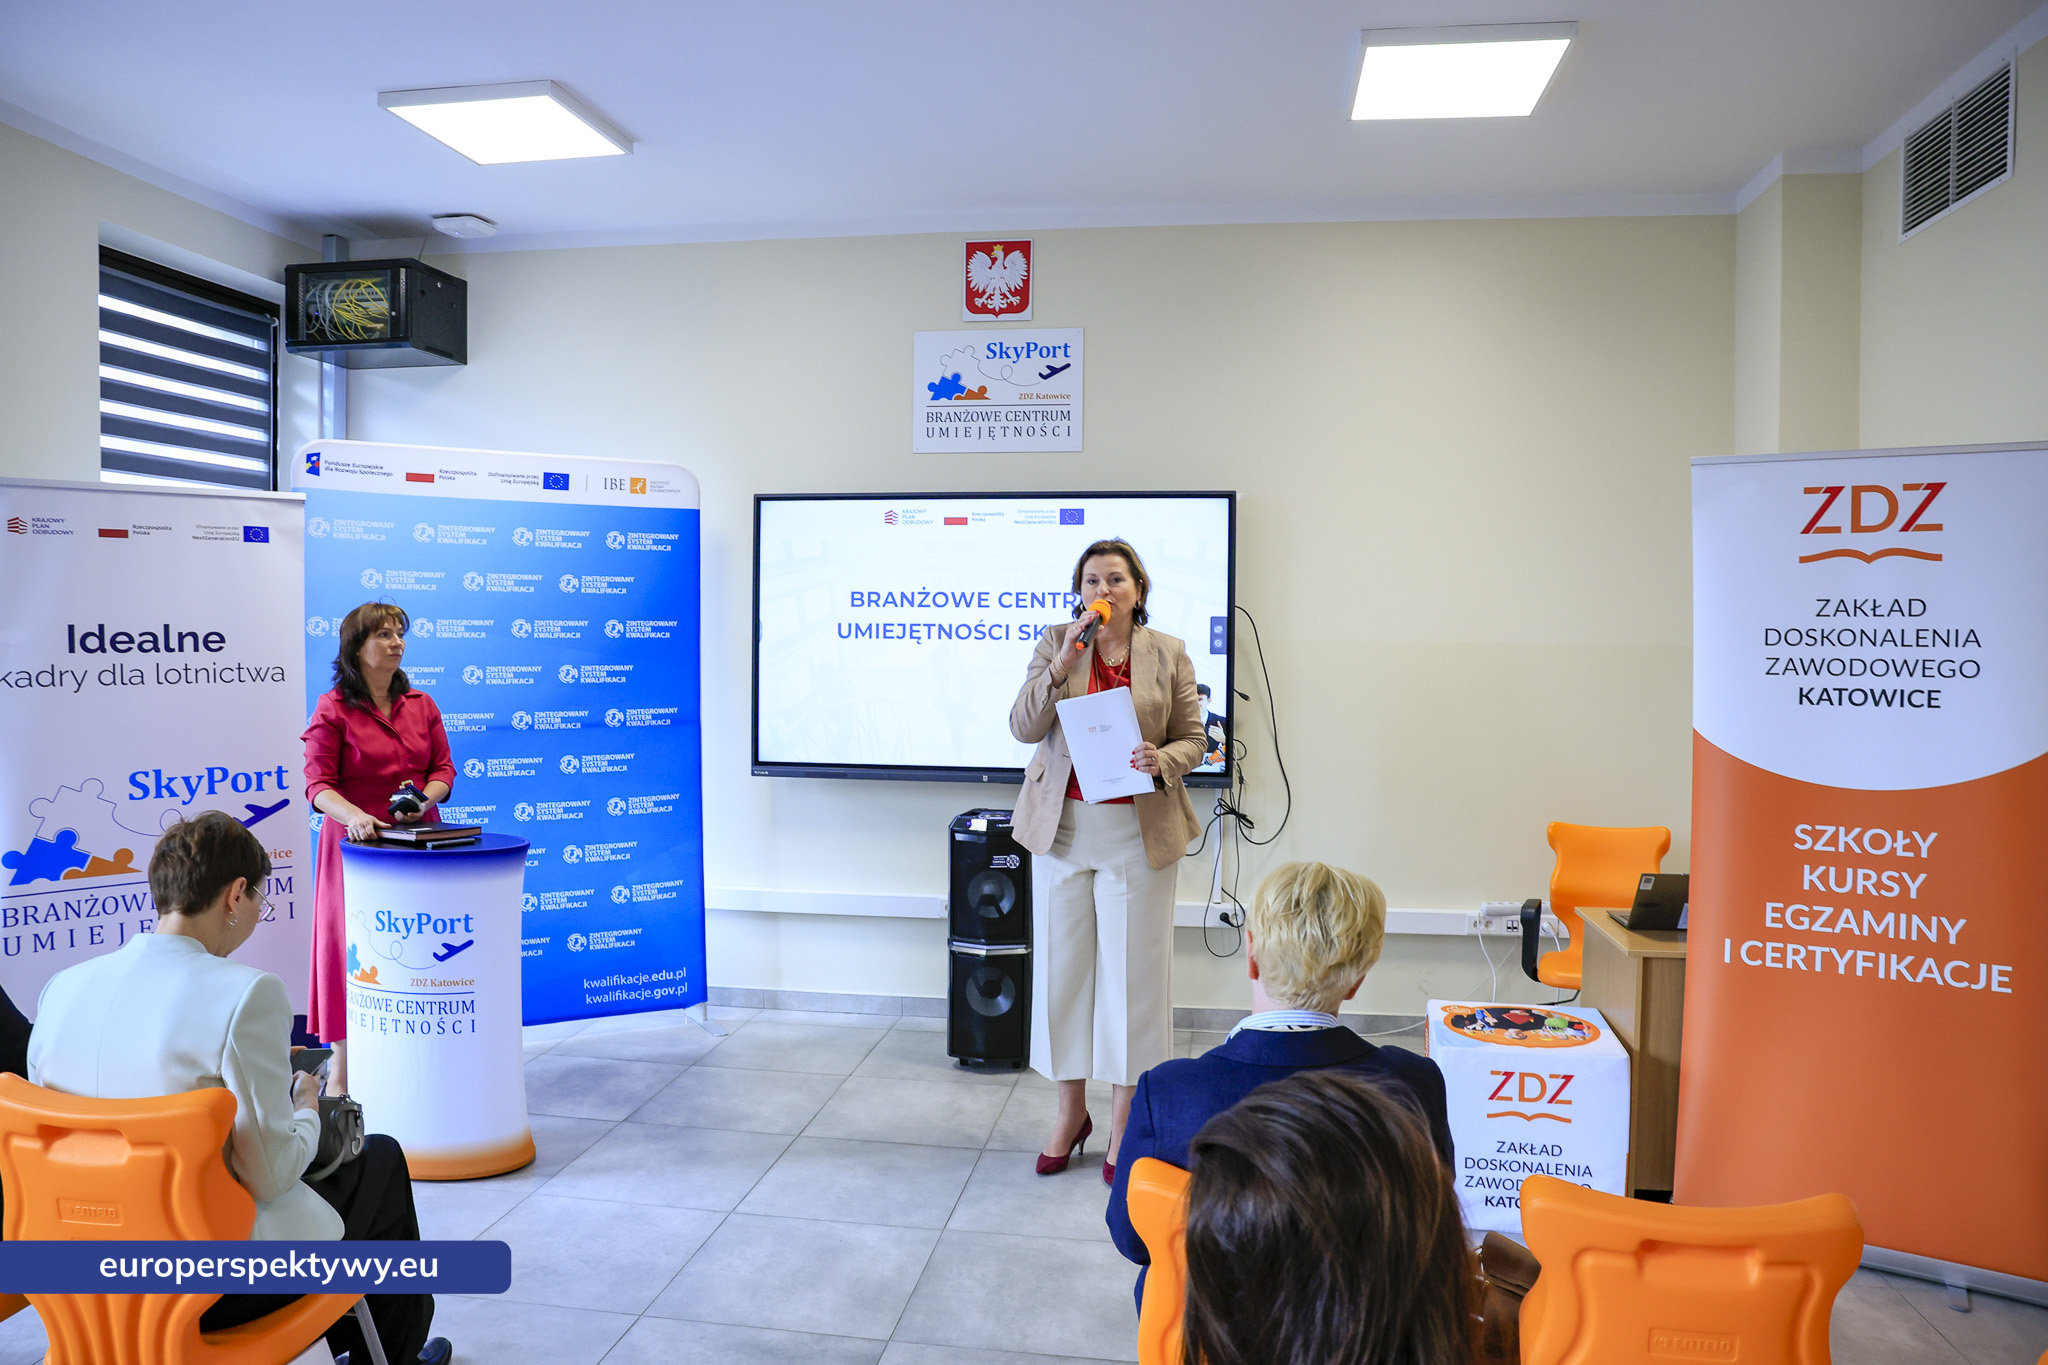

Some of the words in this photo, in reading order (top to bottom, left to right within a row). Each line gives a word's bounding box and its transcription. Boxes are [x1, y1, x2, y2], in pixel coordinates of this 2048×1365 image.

[986, 342, 1071, 364] SkyPort
[926, 409, 1001, 423] BRANŻOWE
[1005, 410, 1071, 422] CENTRUM
[926, 423, 1071, 440] UMIEJĘTNOŚCI
[352, 463, 384, 471] Europejskie
[604, 477, 626, 491] IBE
[1800, 482, 1948, 534] ZDZ
[333, 519, 395, 529] ZINTEGROWANY
[437, 524, 496, 533] ZINTEGROWANY
[333, 532, 386, 541] KWALIFIKACJI
[535, 529, 590, 537] ZINTEGROWANY
[627, 532, 679, 540] ZINTEGROWANY
[437, 537, 487, 545] KWALIFIKACJI
[535, 541, 582, 549] KWALIFIKACJI
[627, 544, 671, 552] KWALIFIKACJI
[385, 570, 446, 579] ZINTEGROWANY
[385, 583, 437, 591] KWALIFIKACJI
[581, 587, 626, 595] KWALIFIKACJI
[850, 587, 990, 608] BRANŻOWE
[1815, 598, 1927, 617] ZAKŁAD
[837, 620, 1010, 644] UMIEJĘTNOŚCI
[67, 624, 226, 653] Idealne
[1764, 628, 1982, 648] DOSKONALENIA
[1765, 657, 1981, 678] ZAWODOWEGO
[98, 663, 145, 686] dla
[156, 662, 286, 684] lotnictwa
[1798, 687, 1941, 709] KATOWICE
[534, 710, 589, 718] ZINTEGROWANY
[626, 707, 678, 715] ZINTEGROWANY
[534, 722, 581, 730] KWALIFIKACJI
[626, 719, 670, 727] KWALIFIKACJI
[487, 757, 543, 765] ZINTEGROWANY
[582, 753, 635, 761] ZINTEGROWANY
[582, 765, 627, 774] KWALIFIKACJI
[128, 766, 290, 805] SkyPort
[628, 794, 680, 803] ZINTEGROWANY
[439, 805, 496, 813] ZINTEGROWANY
[536, 800, 591, 809] ZINTEGROWANY
[628, 806, 672, 815] KWALIFIKACJI
[536, 813, 583, 821] KWALIFIKACJI
[584, 841, 637, 850] ZINTEGROWANY
[1794, 824, 1938, 858] SZKOŁY
[585, 854, 630, 862] KWALIFIKACJI
[632, 880, 684, 891] ZINTEGROWANY
[1803, 864, 1927, 899] KURSY
[540, 889, 595, 898] ZINTEGROWANY
[632, 889, 658, 897] SYSTEM
[632, 892, 677, 902] KWALIFIKACJI
[540, 901, 588, 911] KWALIFIKACJI
[375, 910, 474, 940] SkyPort
[1765, 902, 1967, 945] EGZAMINY
[589, 928, 642, 939] ZINTEGROWANY
[589, 936, 616, 944] SYSTEM
[590, 940, 635, 950] KWALIFIKACJI
[1724, 938, 1731, 963] I
[1740, 940, 2013, 993] CERTYFIKACJE
[410, 978, 428, 987] ZDZ
[430, 978, 475, 987] Katowice
[584, 967, 686, 989] kwalifikacje.edu.pl
[586, 983, 688, 1004] kwalifikacje.gov.pl
[396, 1000, 475, 1015] CENTRUM
[1488, 1070, 1575, 1105] ZDZ
[1496, 1141, 1562, 1157] ZAKŁAD
[1464, 1157, 1593, 1178] DOSKONALENIA
